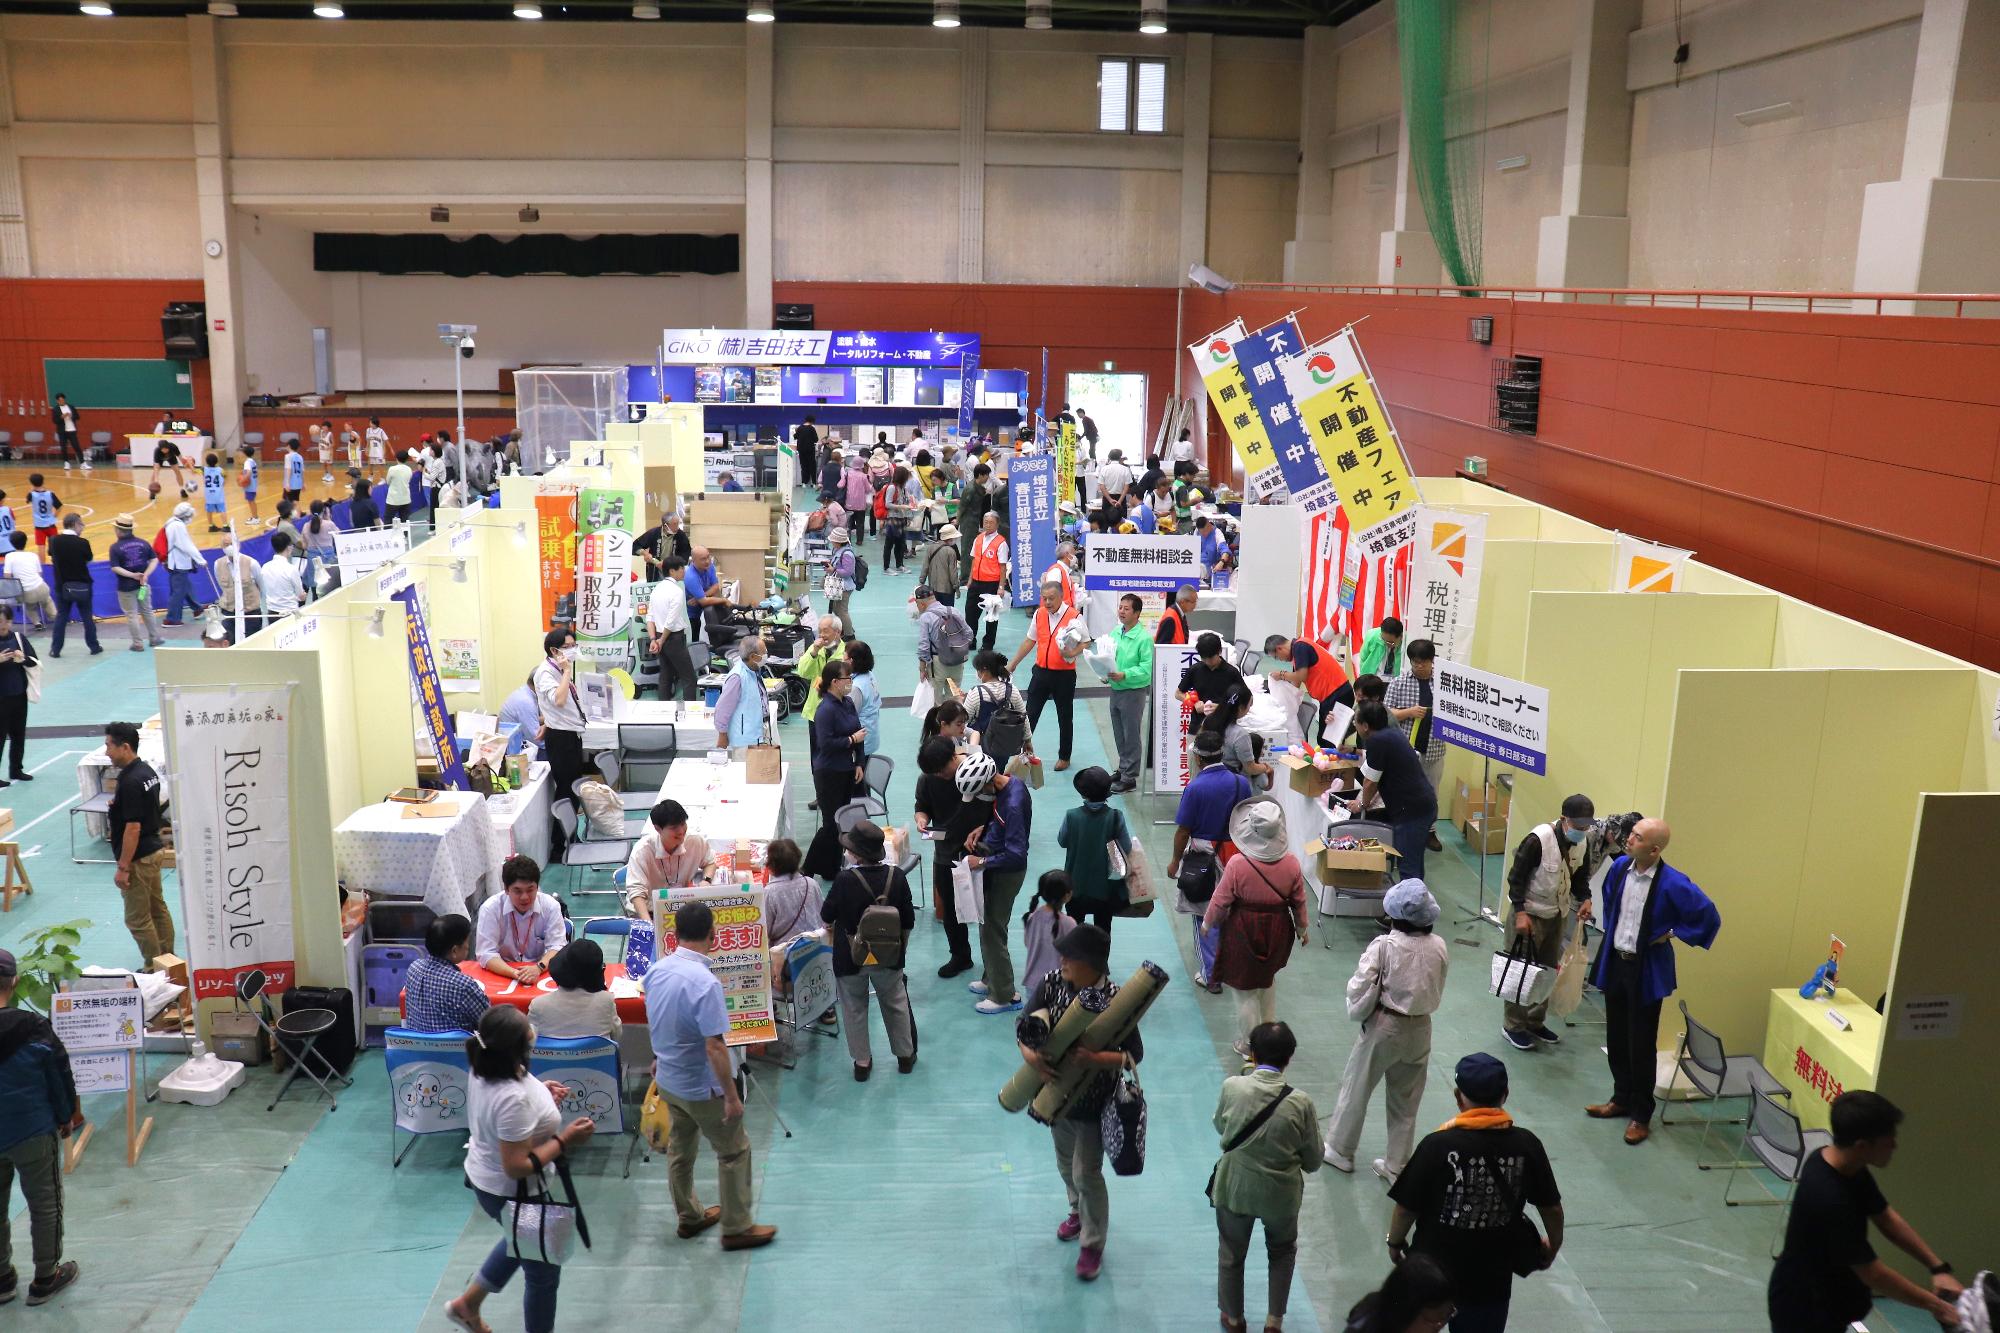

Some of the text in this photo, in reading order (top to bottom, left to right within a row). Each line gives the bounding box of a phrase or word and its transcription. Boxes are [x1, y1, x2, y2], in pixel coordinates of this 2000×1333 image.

[717, 337, 825, 356] (株)吉田技工
[832, 349, 931, 360] トータルリフォーム・不動産
[1219, 384, 1262, 456] 開催中
[1252, 361, 1305, 464] 開催中
[1012, 459, 1048, 473] ようこそ
[1319, 412, 1373, 508] 開催中
[1336, 382, 1401, 511] 不動産フェア
[205, 475, 220, 488] 24
[1033, 474, 1049, 521] 埼玉県立
[39, 500, 48, 514] 8
[540, 516, 561, 560] 試乗
[1015, 482, 1034, 602] 春日部高等技術専門校
[1092, 547, 1193, 565] 不動産無料相談会
[582, 575, 602, 631] 取扱店
[606, 534, 625, 629] シニアカー
[1440, 670, 1540, 714] 無料相談コーナー
[1442, 725, 1536, 767] 関東信越税理士会 春日部支部
[223, 746, 264, 950] Risoh Style
[73, 996, 137, 1010] 天然無垢の端材
